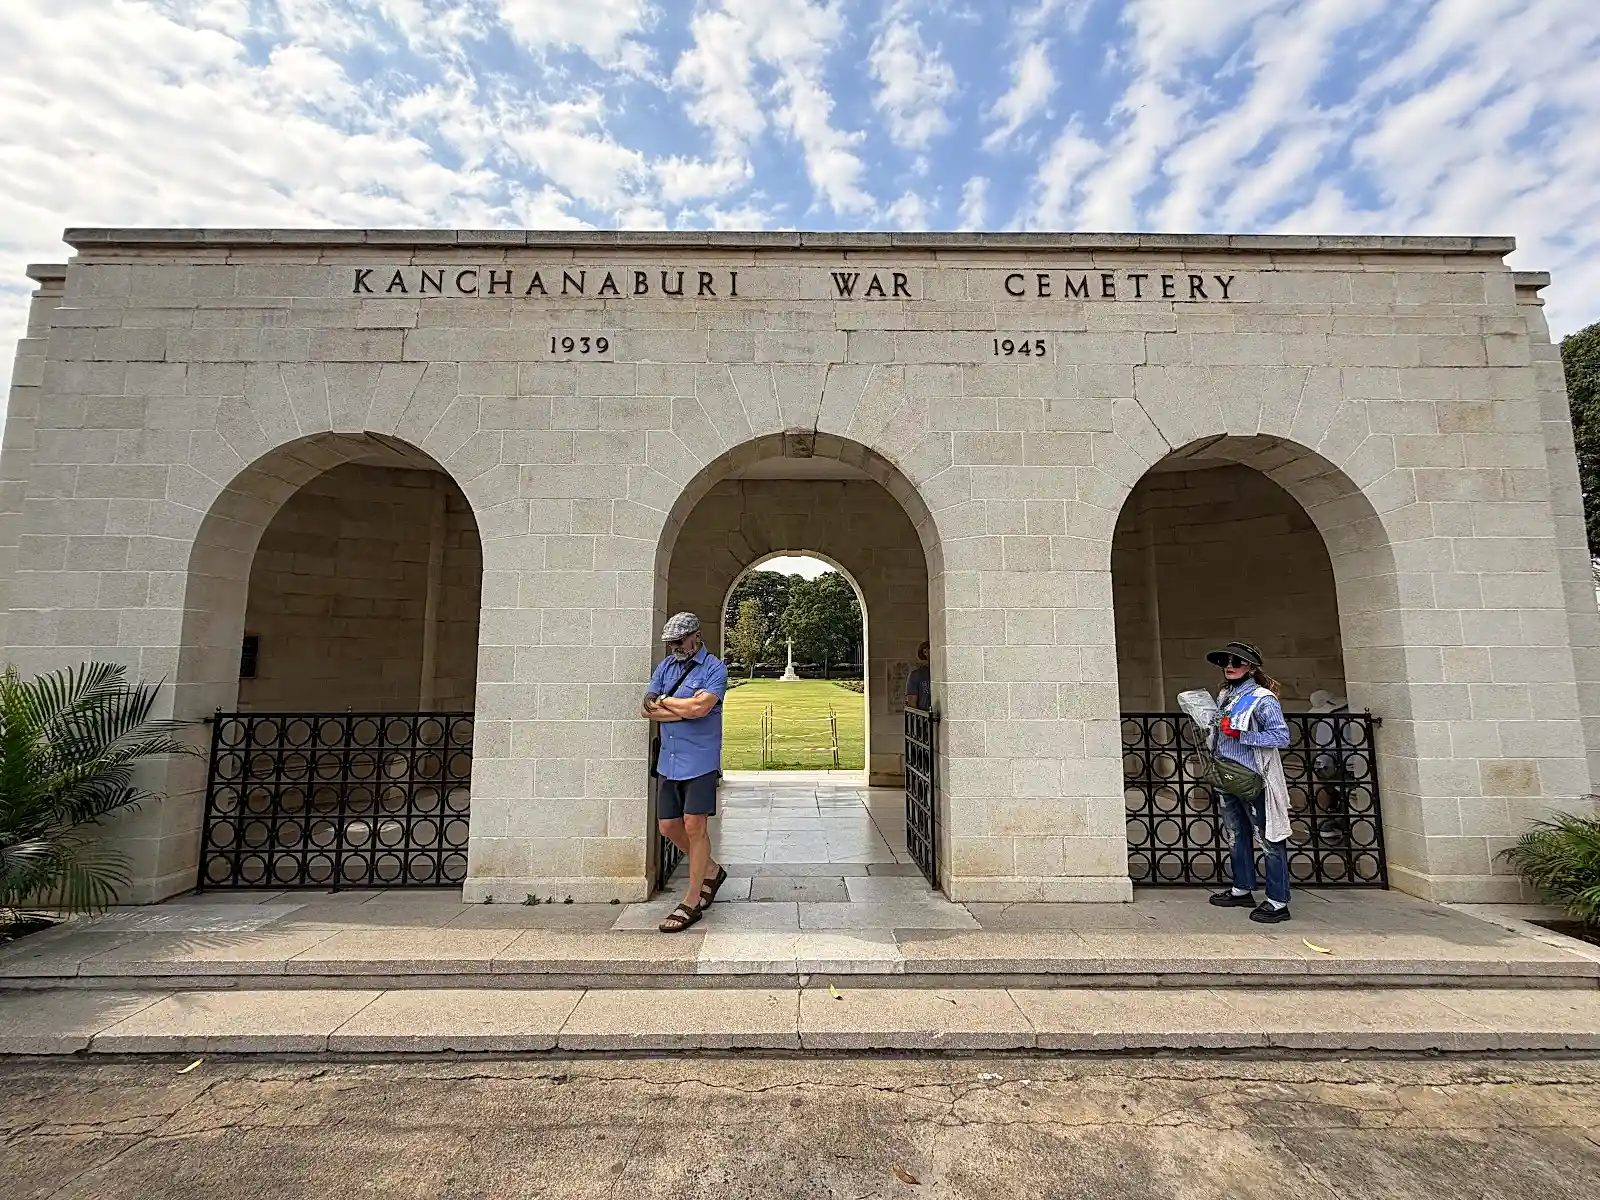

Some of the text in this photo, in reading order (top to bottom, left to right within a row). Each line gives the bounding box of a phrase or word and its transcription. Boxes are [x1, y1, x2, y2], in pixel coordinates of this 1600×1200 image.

[353, 269, 1235, 299] KANCHANABURI WAR CEMETERY
[550, 336, 1046, 356] 1939 1945
